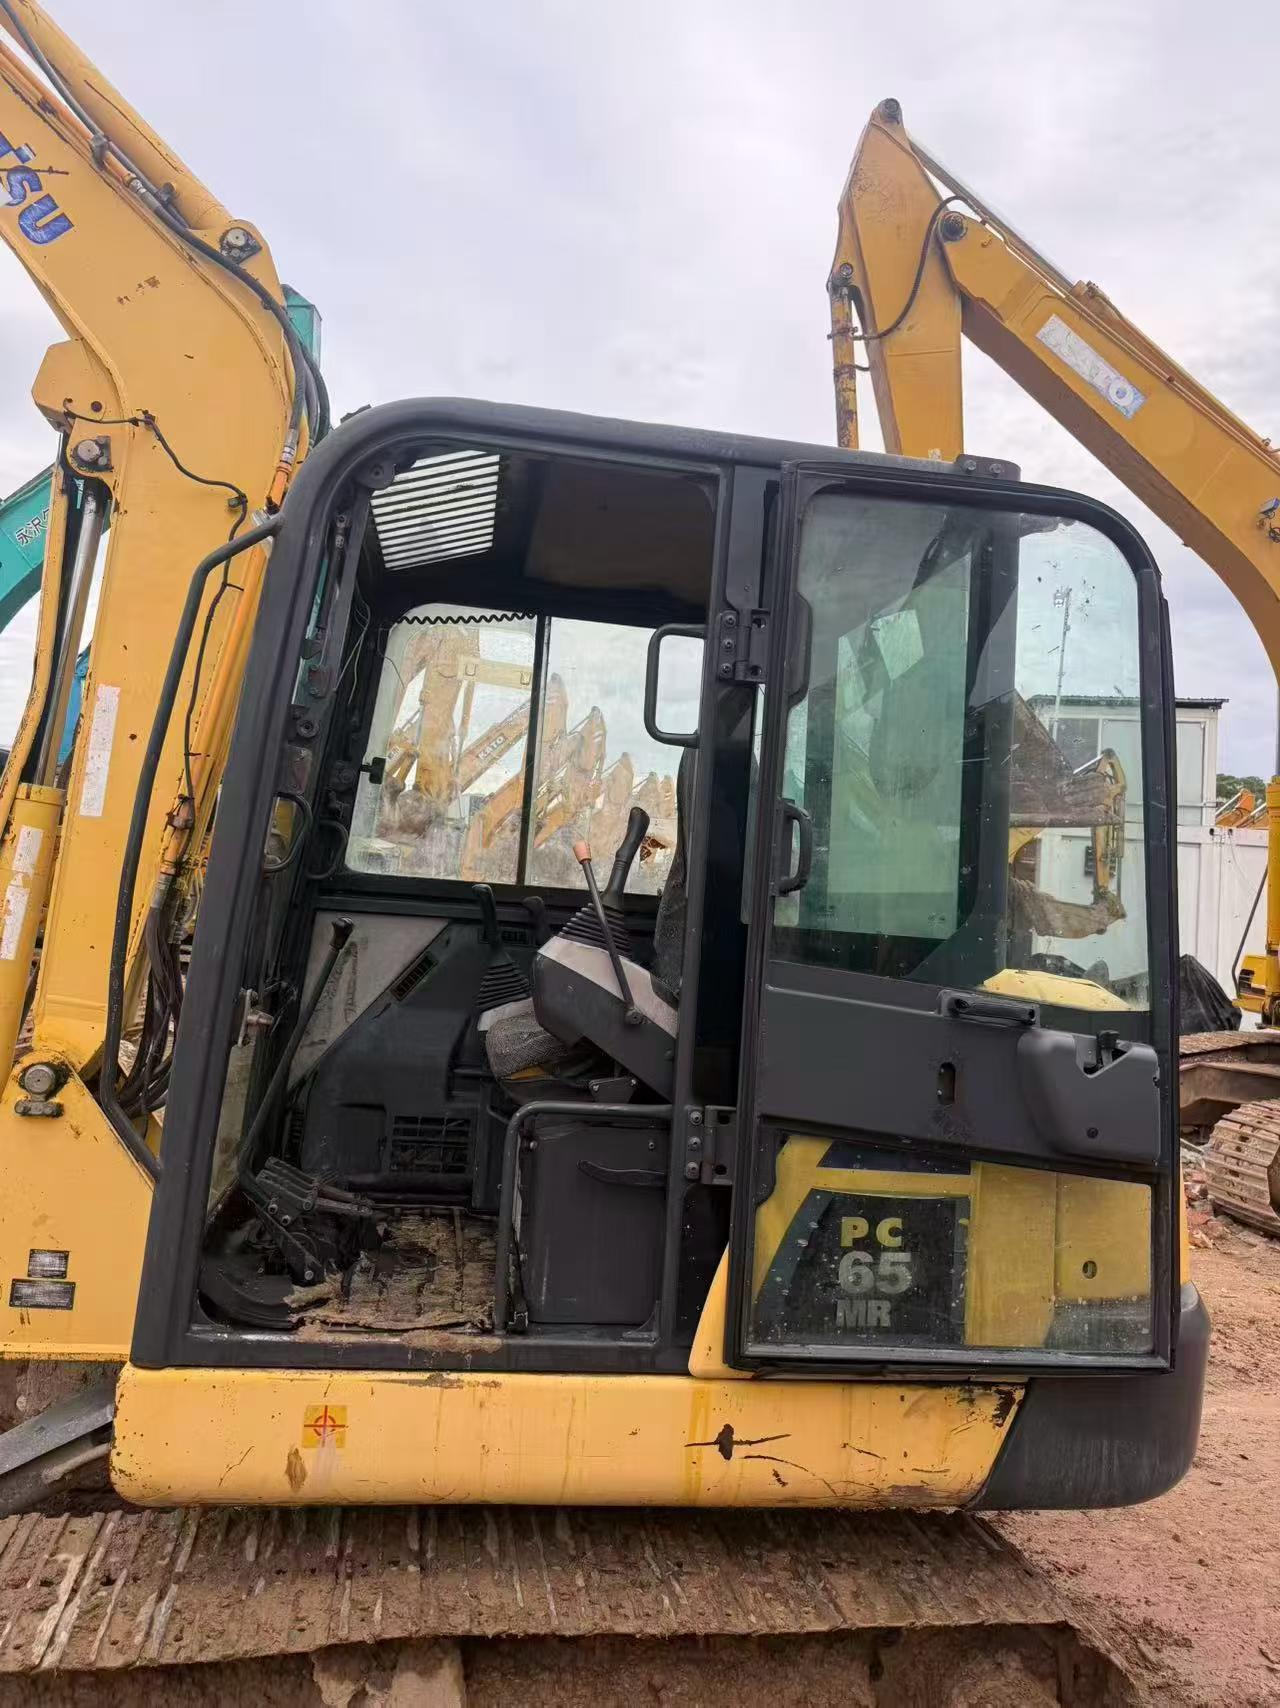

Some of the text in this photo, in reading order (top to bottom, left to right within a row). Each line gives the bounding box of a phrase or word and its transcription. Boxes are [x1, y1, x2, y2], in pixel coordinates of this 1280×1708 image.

[478, 734, 505, 760] KATO
[840, 1216, 903, 1248] PC
[838, 1250, 912, 1294] 65
[836, 1299, 891, 1327] MR
